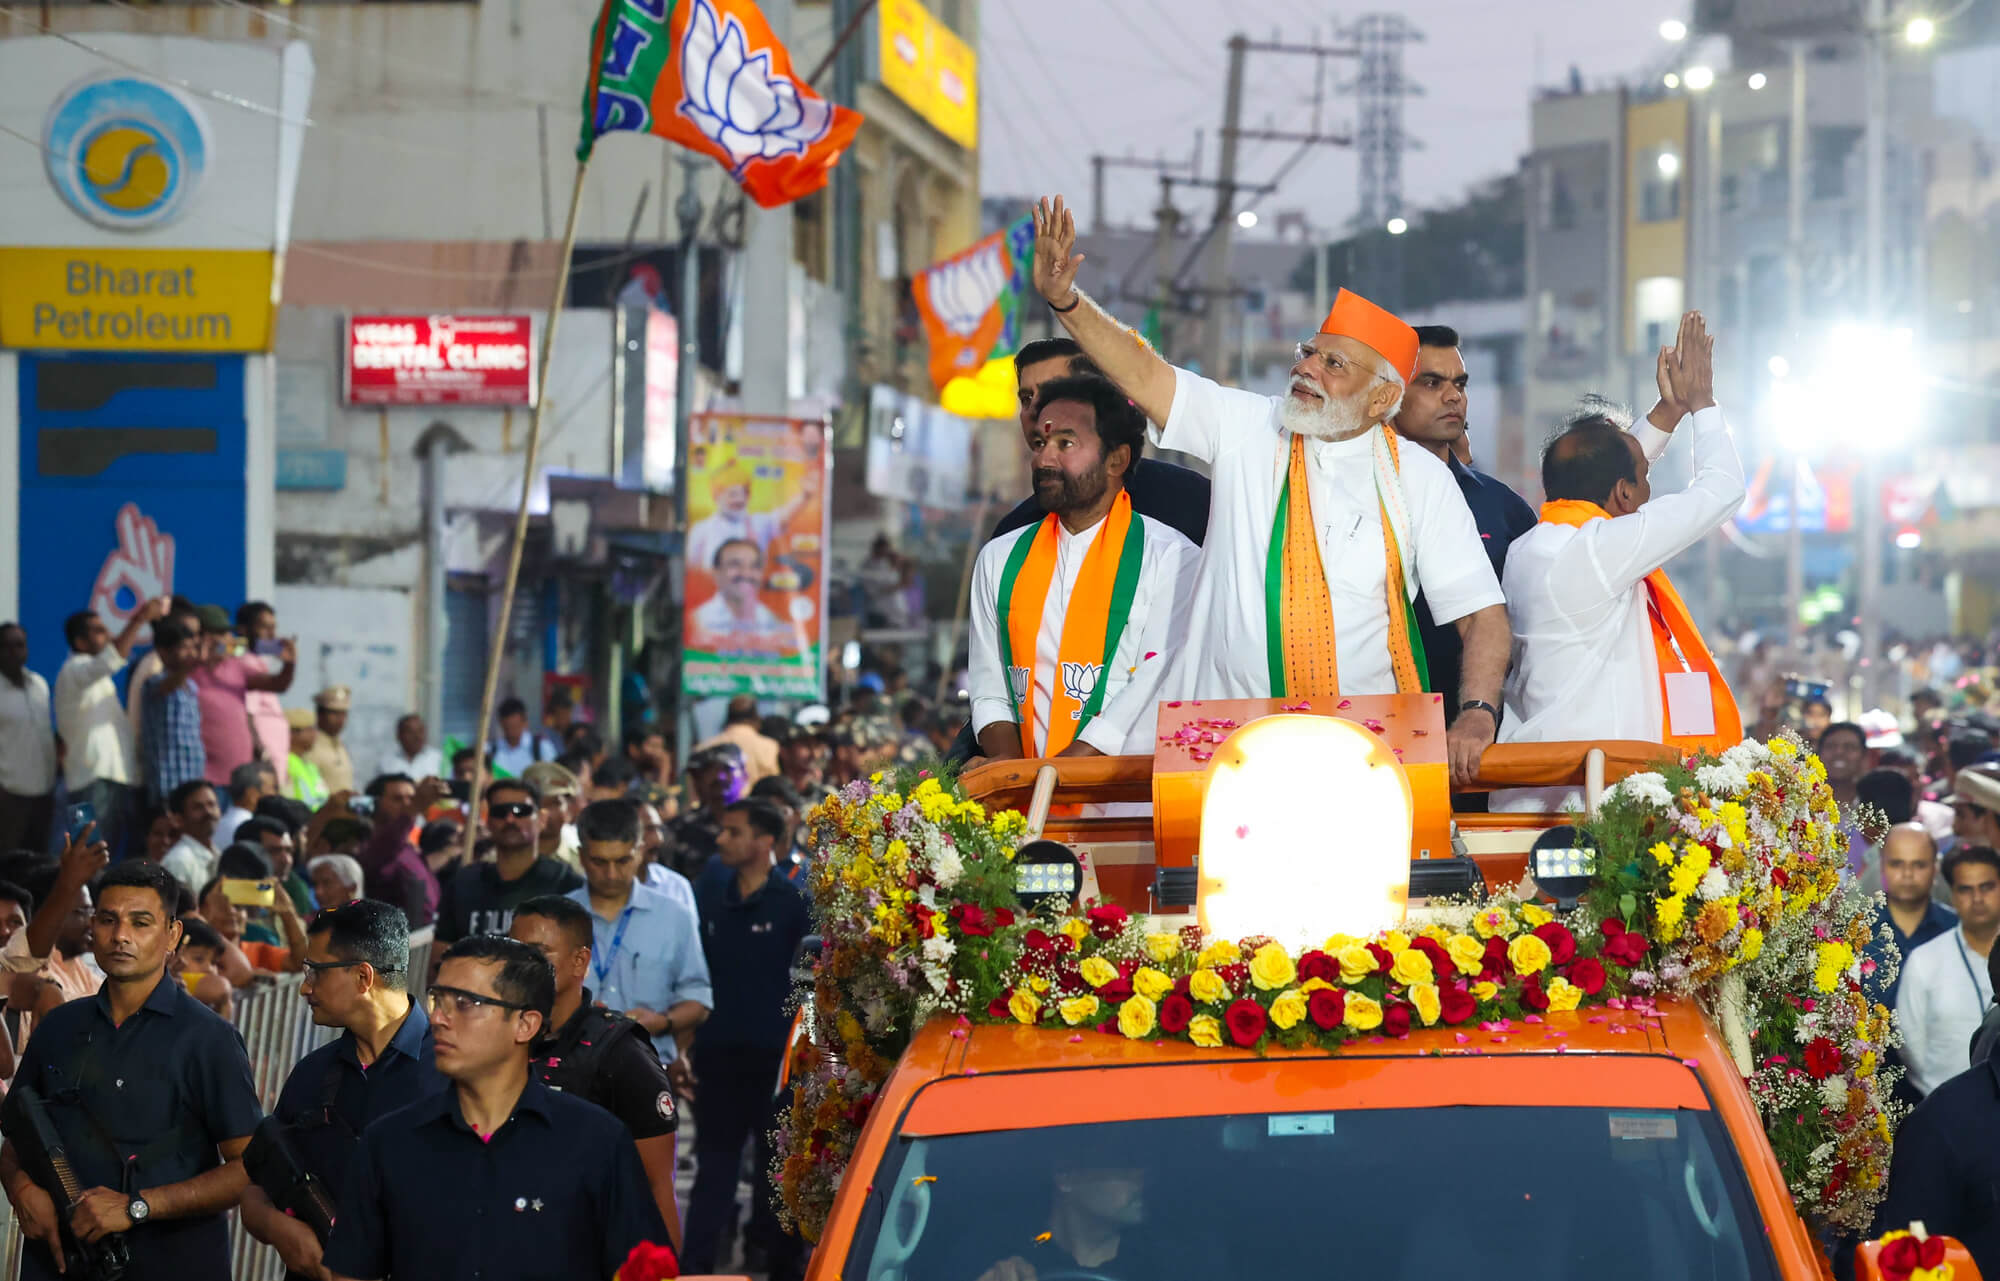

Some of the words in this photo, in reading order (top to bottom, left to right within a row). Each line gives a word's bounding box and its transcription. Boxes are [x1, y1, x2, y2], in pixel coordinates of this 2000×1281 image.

[65, 260, 196, 296] Bharat
[33, 303, 233, 340] Petroleum
[353, 343, 445, 369] DENTAL
[448, 344, 527, 370] CLINIC
